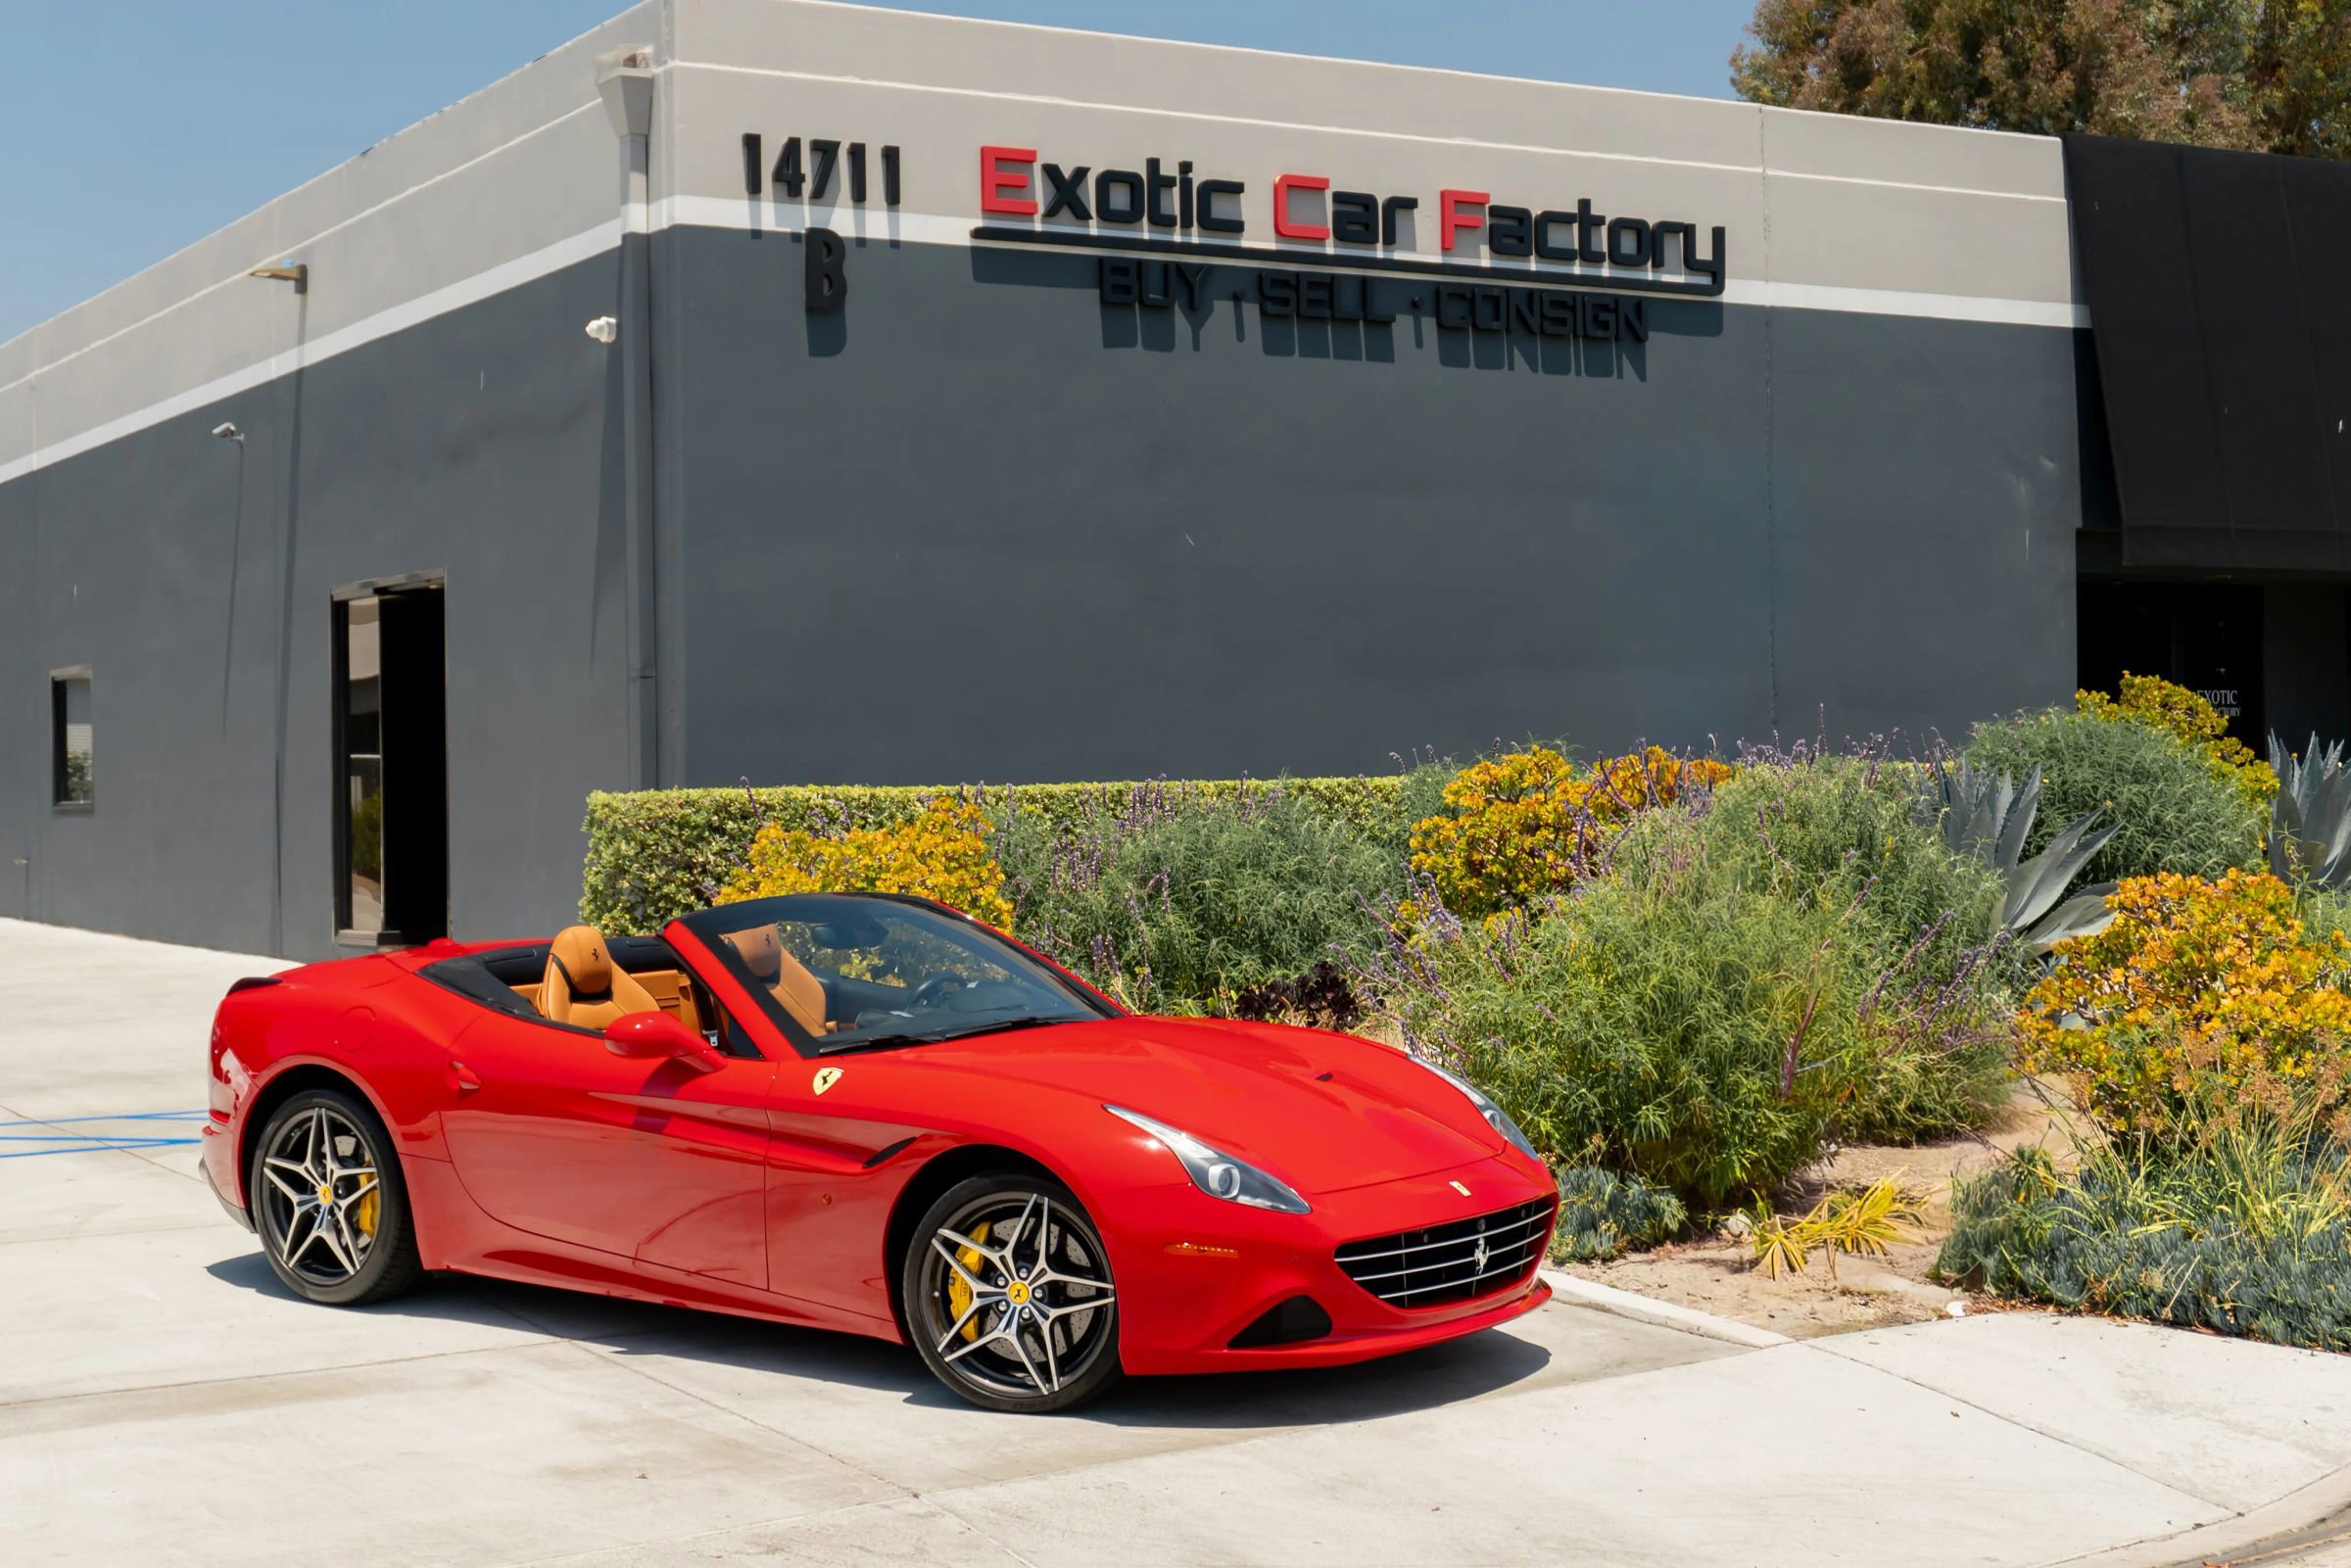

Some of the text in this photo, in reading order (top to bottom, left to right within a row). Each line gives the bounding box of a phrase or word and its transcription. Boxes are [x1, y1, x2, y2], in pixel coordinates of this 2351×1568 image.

[742, 133, 901, 205] 14711
[980, 146, 1725, 296] Exotic Car Factory
[805, 227, 847, 312] B
[1099, 258, 1648, 342] BUY SELL CONSIGN
[2214, 707, 2241, 717] ACTORY
